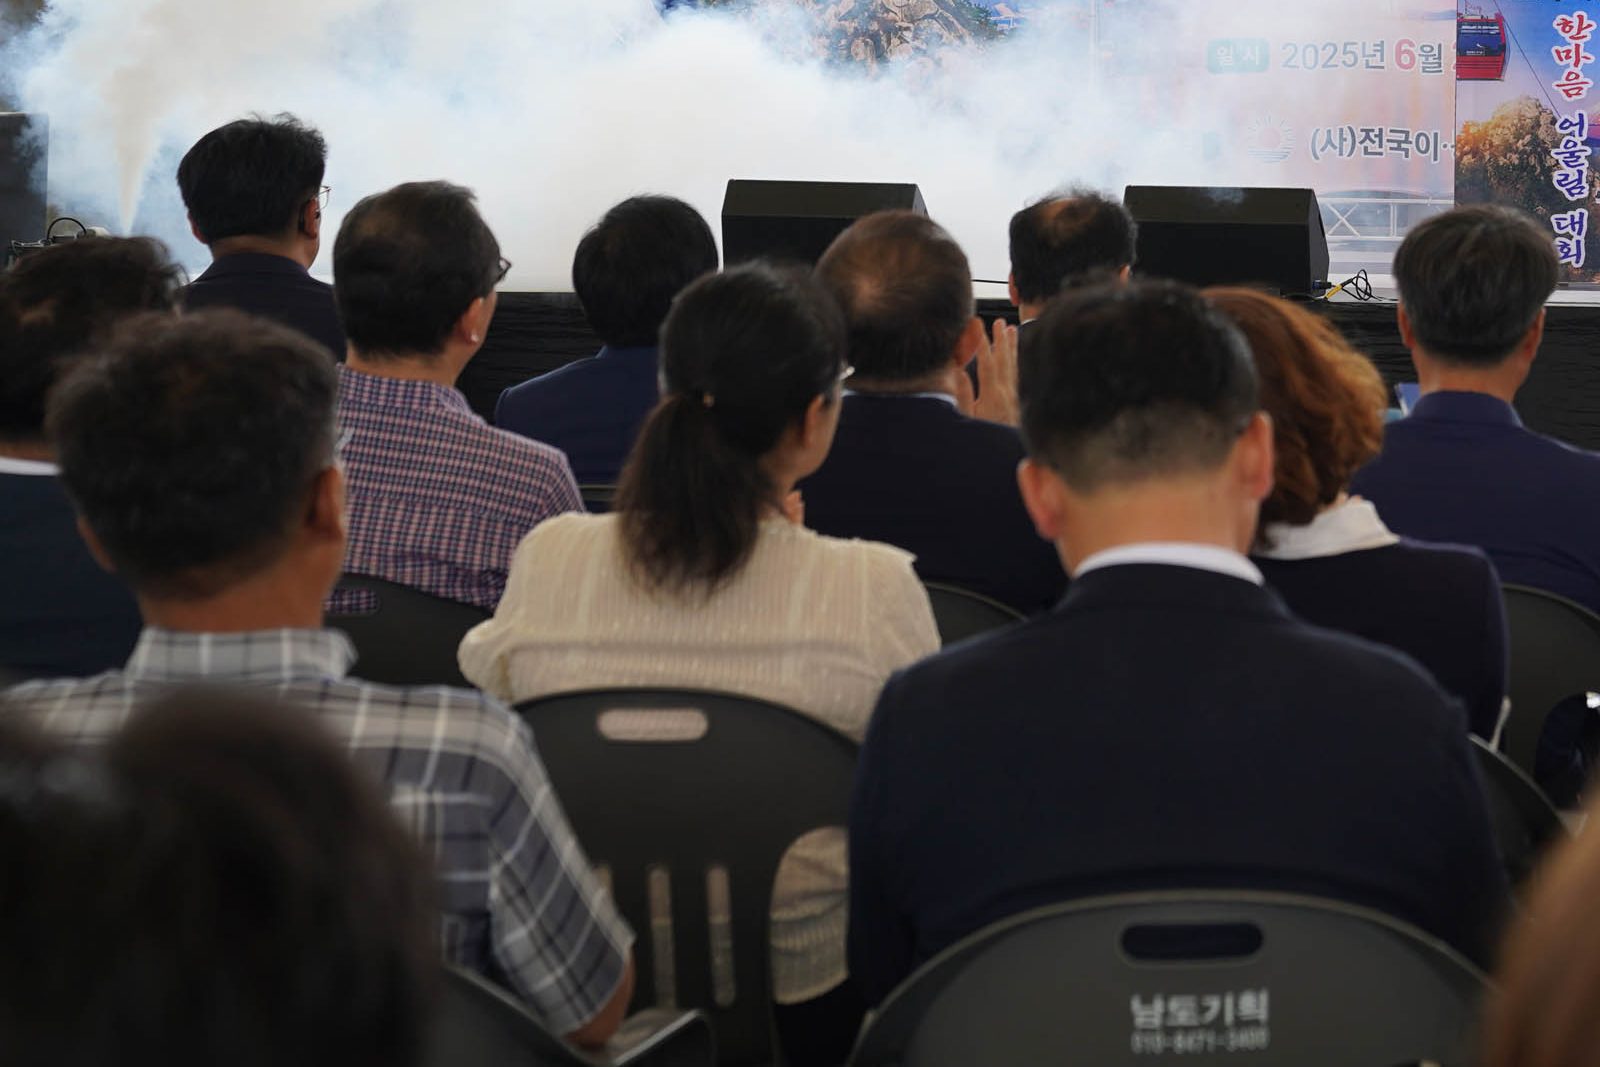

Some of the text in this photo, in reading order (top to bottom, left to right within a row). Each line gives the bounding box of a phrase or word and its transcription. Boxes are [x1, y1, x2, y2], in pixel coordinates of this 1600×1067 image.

[1281, 39, 1386, 71] 2025년
[1394, 38, 1443, 74] 6월
[1551, 11, 1598, 268] 한마음 어울림 대회
